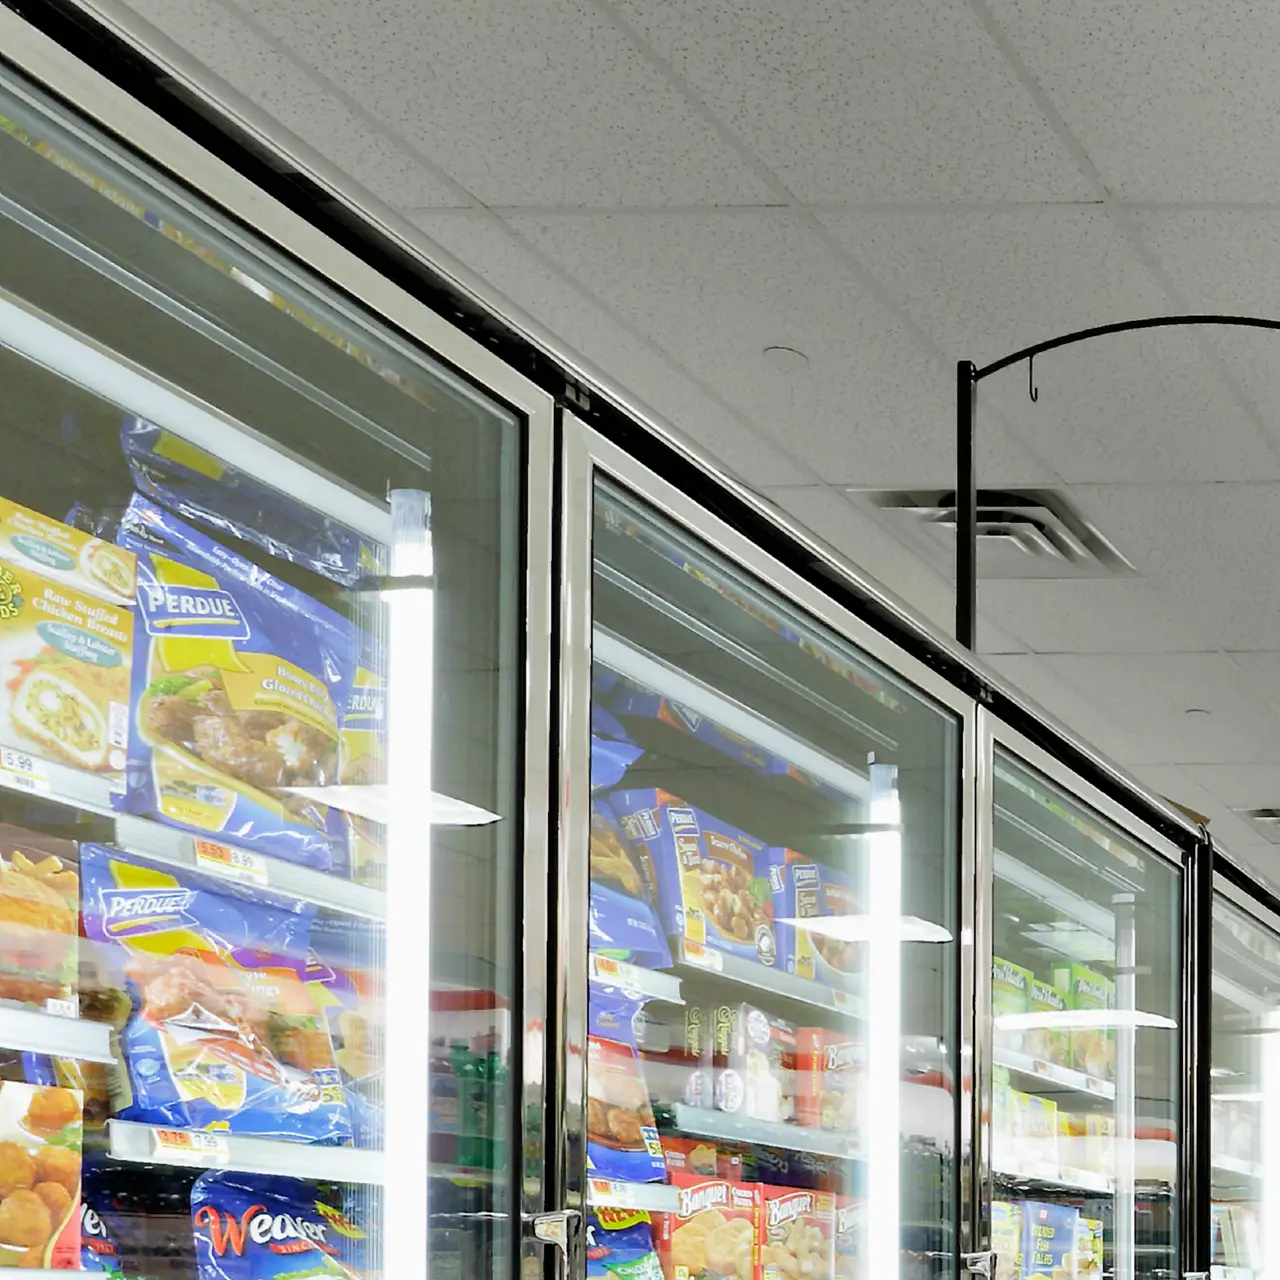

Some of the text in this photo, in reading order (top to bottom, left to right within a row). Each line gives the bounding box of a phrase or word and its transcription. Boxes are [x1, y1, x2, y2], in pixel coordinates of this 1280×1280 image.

[32, 600, 84, 627] Chicken
[149, 591, 236, 618] PERDUE
[110, 892, 192, 919] PERDUE
[681, 1184, 727, 1217] Banquet
[769, 1195, 812, 1226] Banquet
[195, 1202, 328, 1259] Weaver
